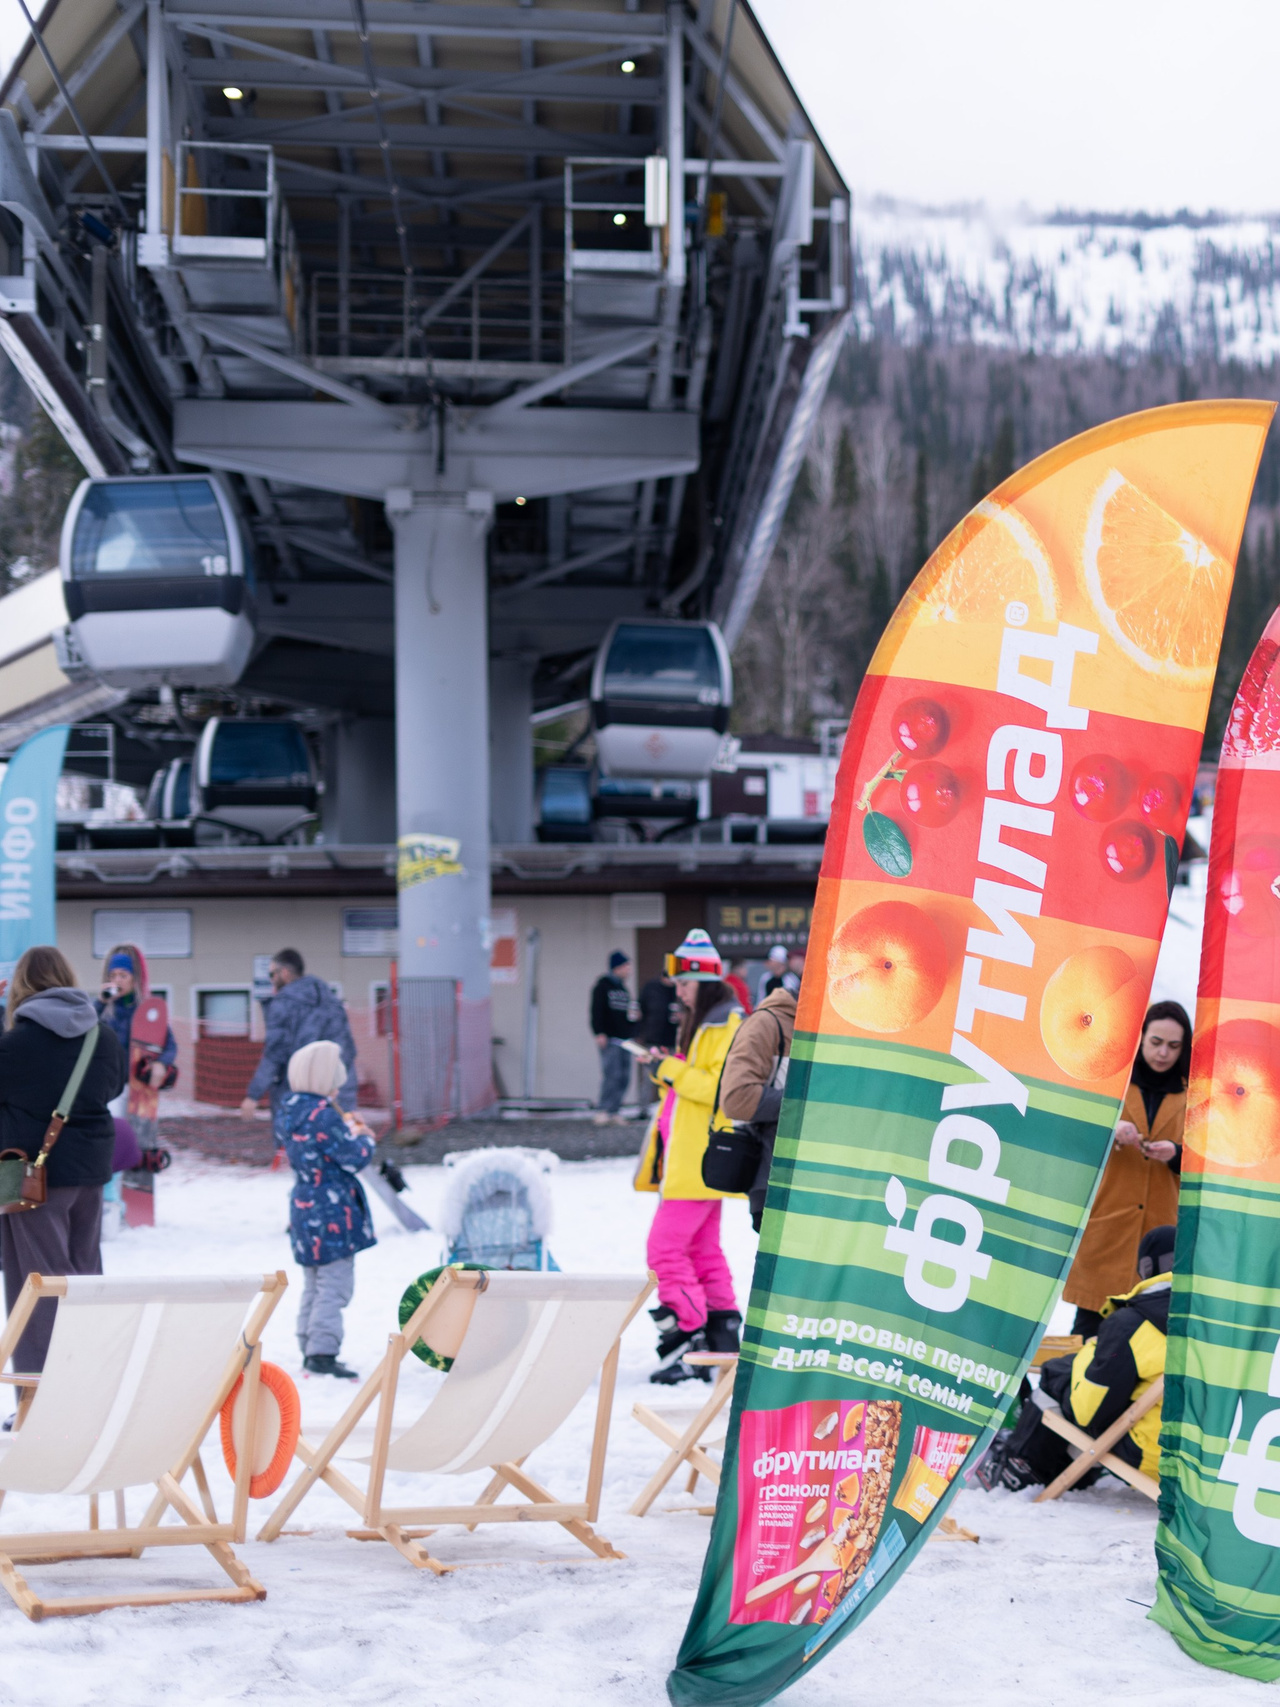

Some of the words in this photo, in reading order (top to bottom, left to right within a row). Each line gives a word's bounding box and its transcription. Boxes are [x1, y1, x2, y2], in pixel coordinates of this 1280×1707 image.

[0, 797, 38, 919] ИНФО
[782, 1314, 928, 1361] здоровые
[771, 1346, 831, 1371] для
[837, 1353, 904, 1387] всей
[908, 1373, 974, 1414] семьи
[759, 1483, 830, 1500] гранола
